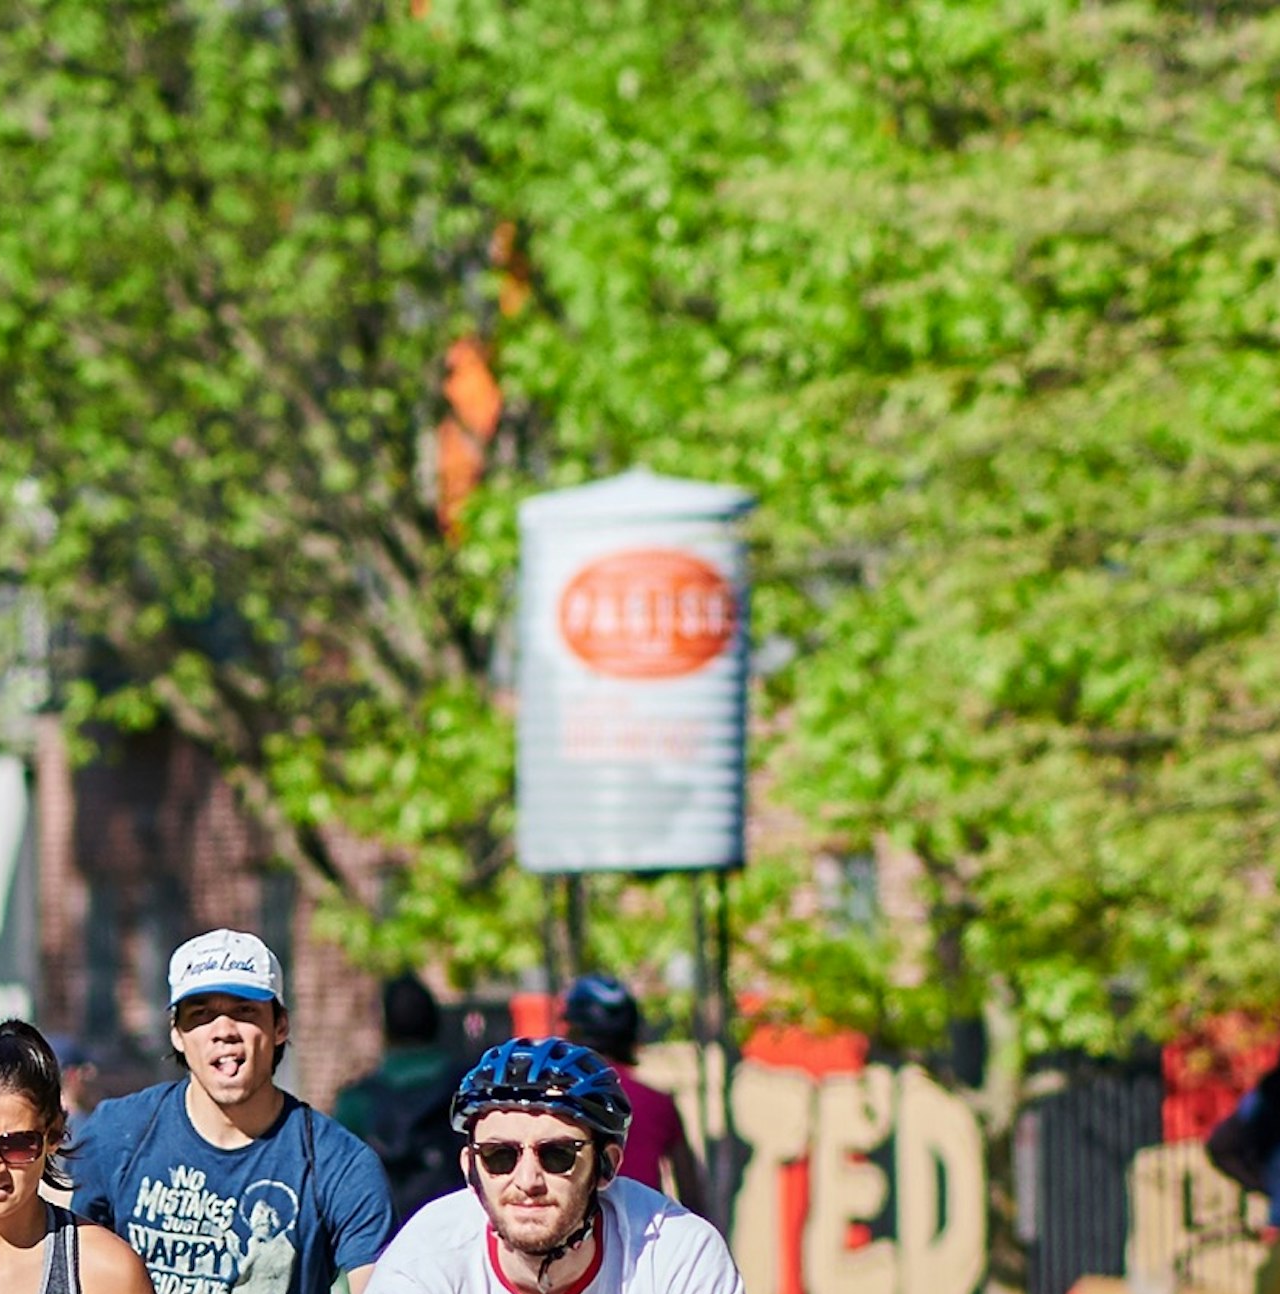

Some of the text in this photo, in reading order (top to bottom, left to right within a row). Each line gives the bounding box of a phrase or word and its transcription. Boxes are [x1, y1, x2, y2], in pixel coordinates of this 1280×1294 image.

[169, 1164, 206, 1191] NO
[133, 1176, 237, 1231] MISTAKES
[162, 1214, 200, 1234] JUST
